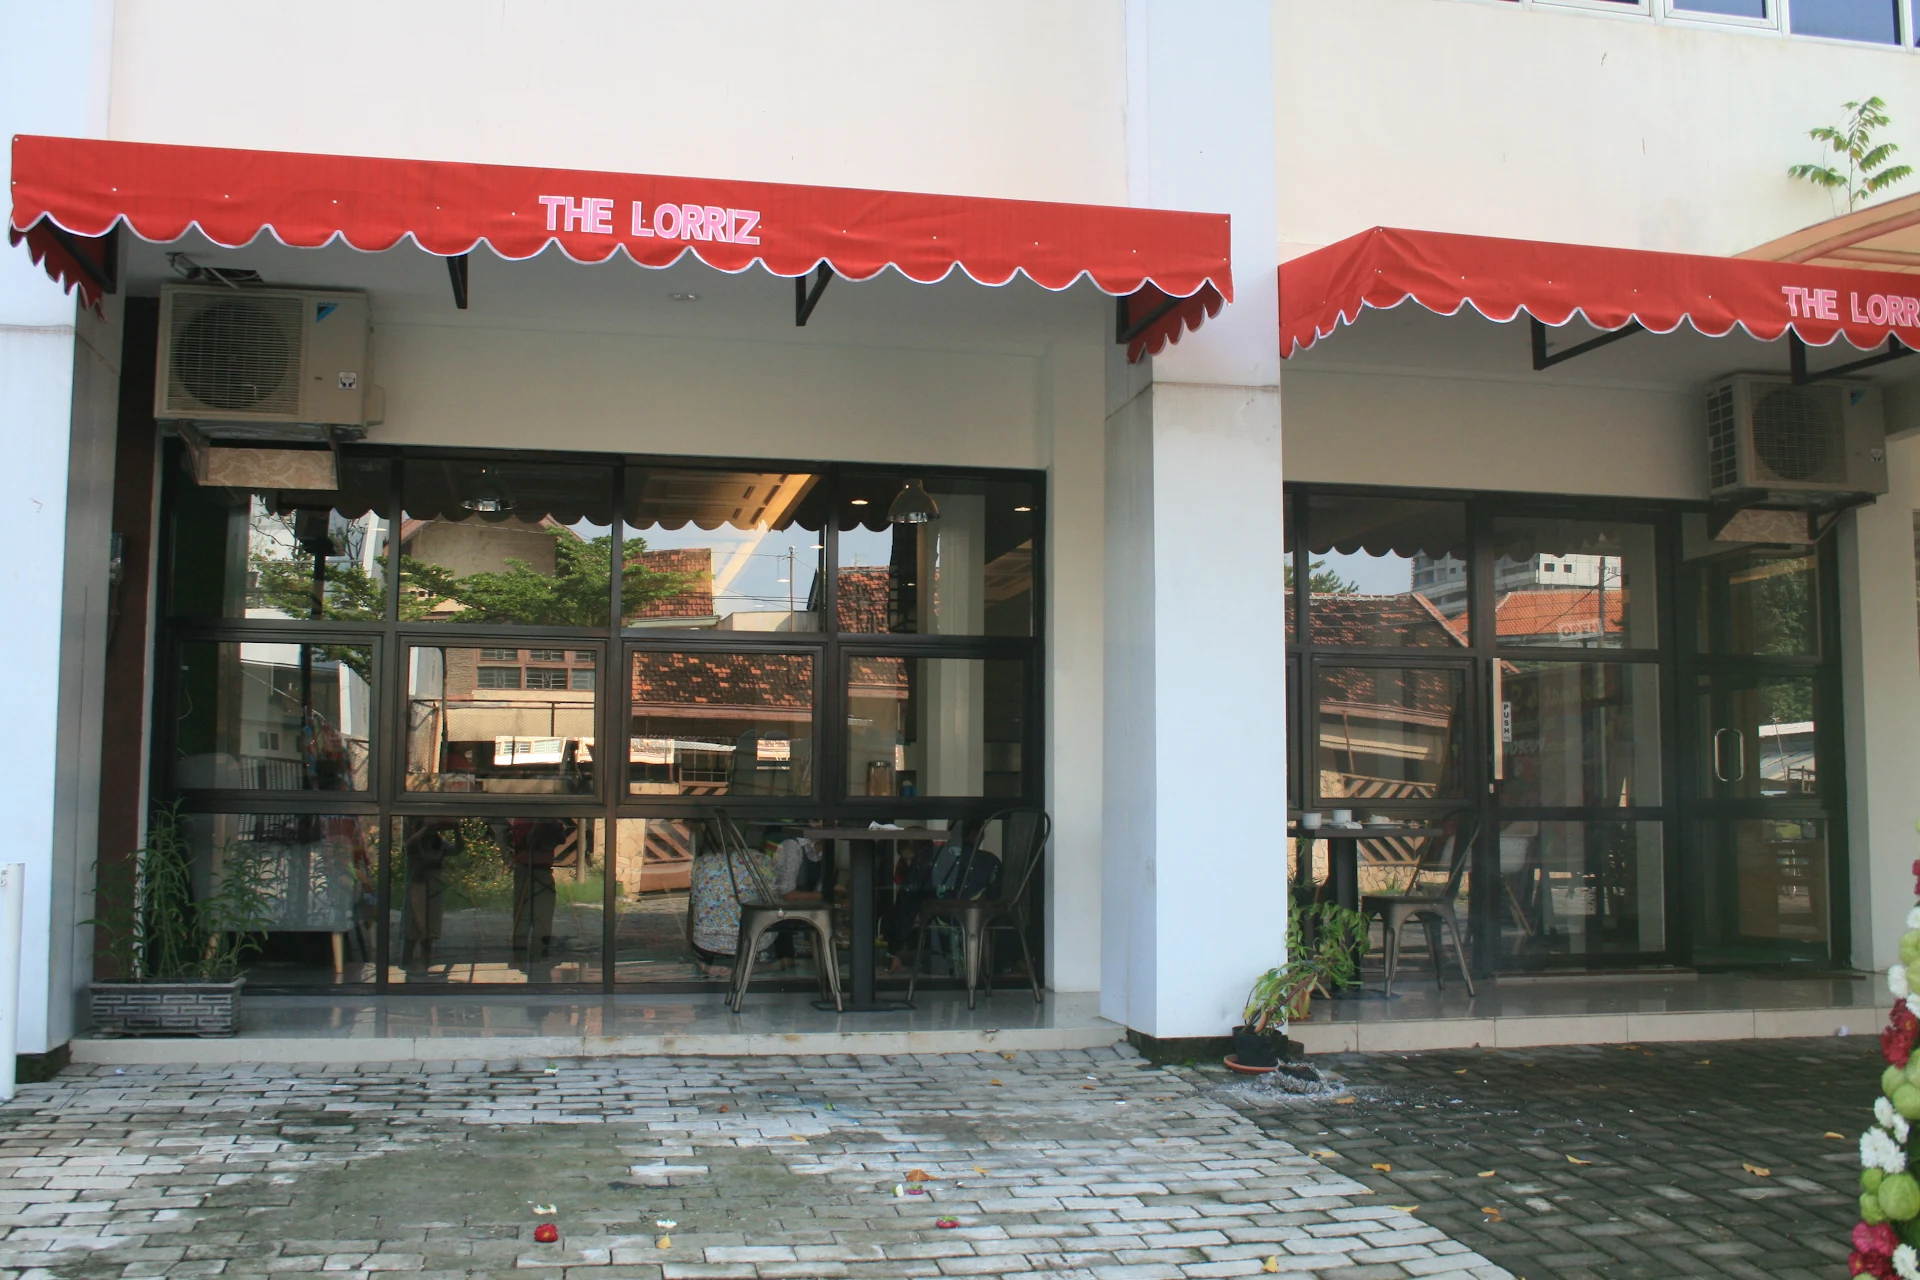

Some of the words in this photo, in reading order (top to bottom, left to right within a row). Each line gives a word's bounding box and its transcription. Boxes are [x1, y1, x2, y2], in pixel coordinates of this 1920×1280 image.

[538, 195, 614, 234] THE
[631, 200, 761, 246] LORRIZ
[1781, 285, 1839, 321] THE
[1850, 291, 1920, 328] LORR
[1560, 621, 1599, 637] OPEN
